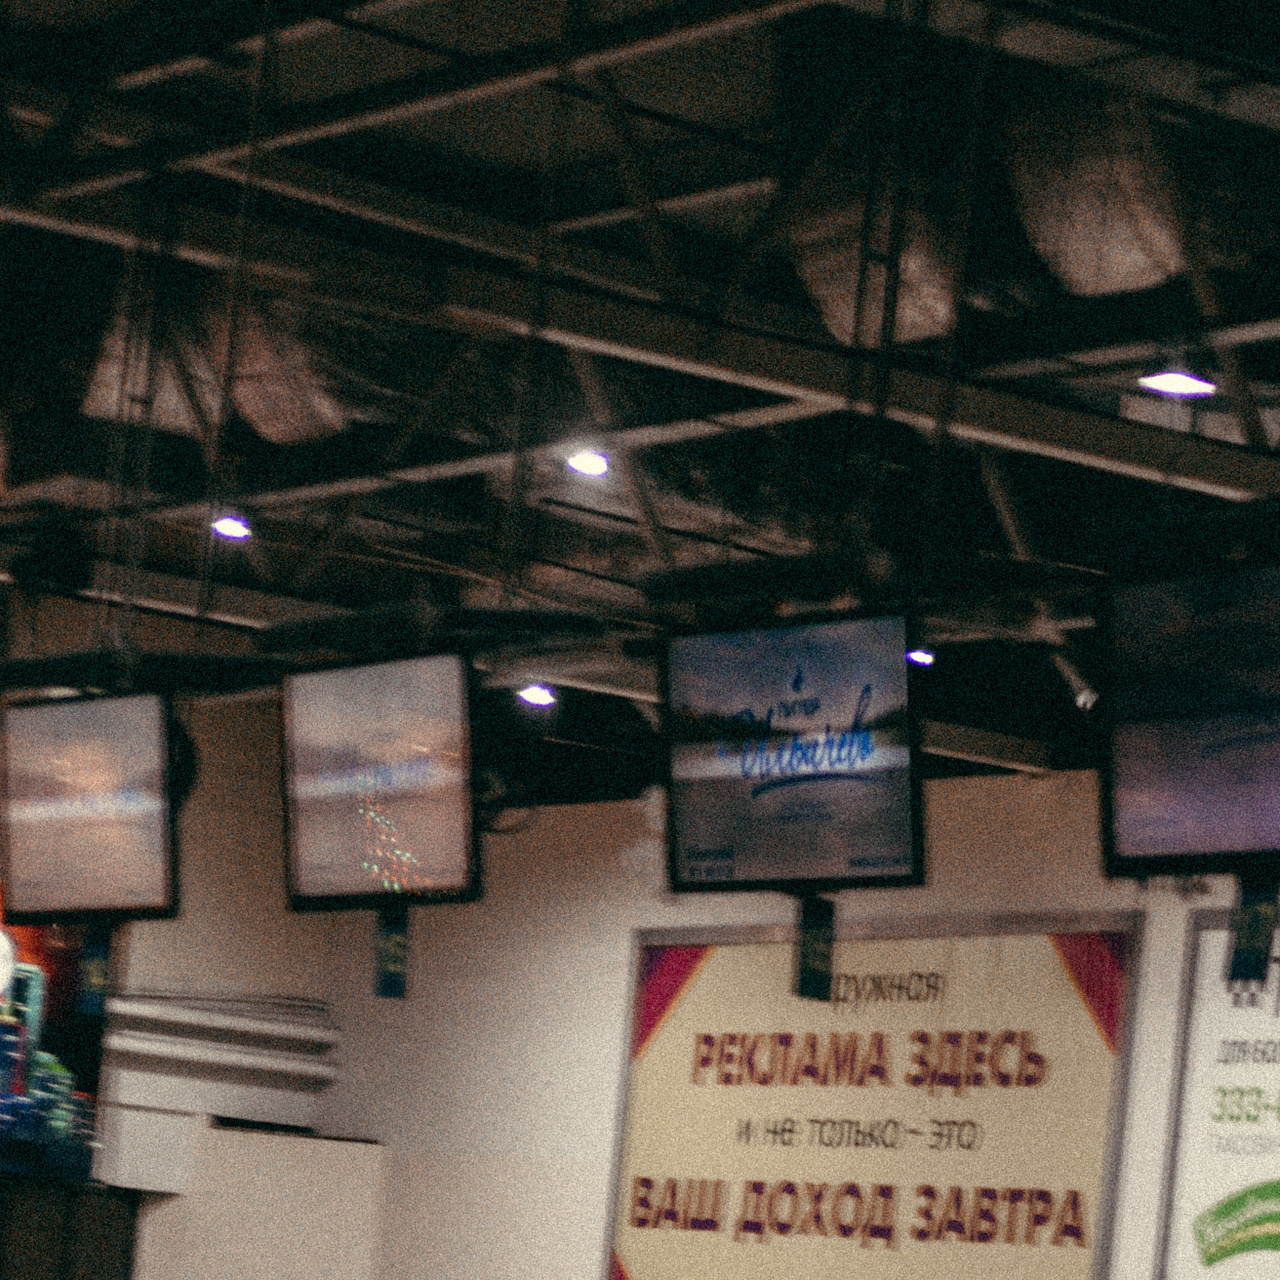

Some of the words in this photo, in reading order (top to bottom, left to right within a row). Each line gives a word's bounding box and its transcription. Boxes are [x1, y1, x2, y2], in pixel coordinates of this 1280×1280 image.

[833, 969, 948, 1012] ружная
[691, 1032, 891, 1087] РЕКЛАМА
[904, 1030, 1050, 1099] ЗДЕСЬ
[628, 1177, 725, 1233] ВАШ
[734, 1180, 898, 1249] ДОХОД
[911, 1183, 1089, 1249] ЗАВТРА
